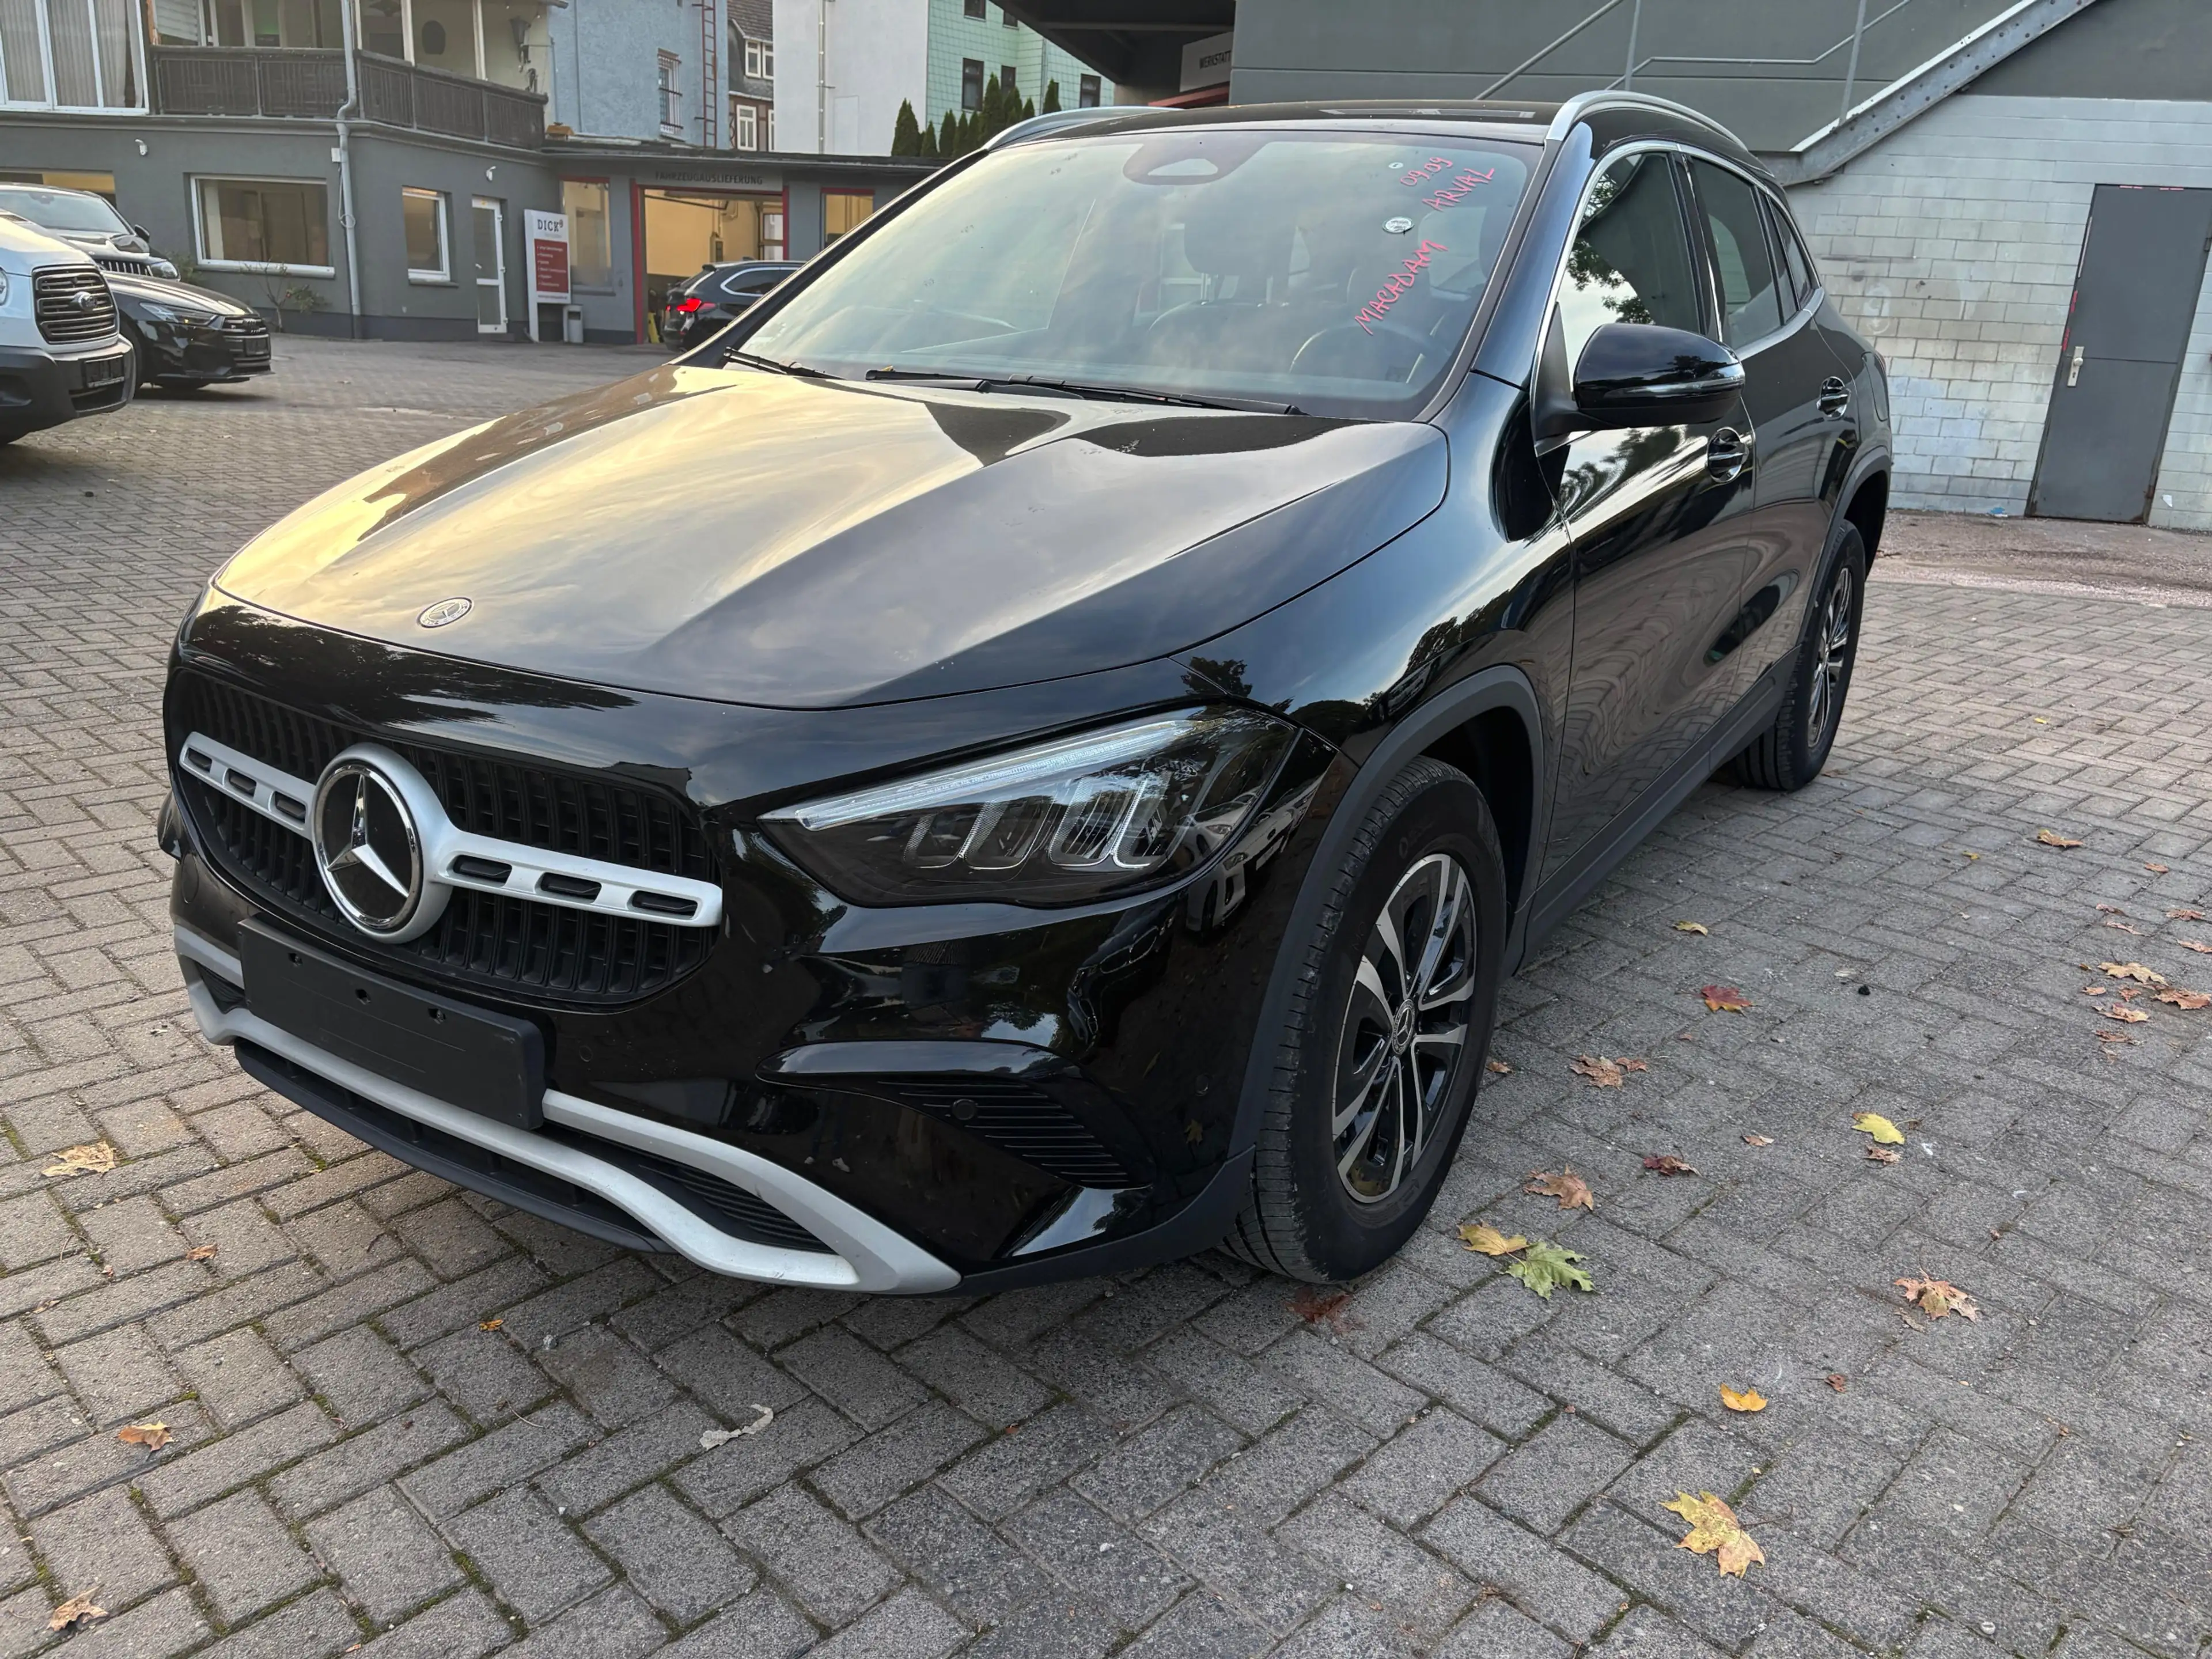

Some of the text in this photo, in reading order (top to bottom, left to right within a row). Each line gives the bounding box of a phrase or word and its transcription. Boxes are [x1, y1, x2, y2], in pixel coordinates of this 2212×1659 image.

[655, 171, 763, 185] FAHRZEUGAUSLIEFERUNG
[1422, 168, 1495, 211] ARVAL
[1354, 239, 1449, 336] MACADAM
